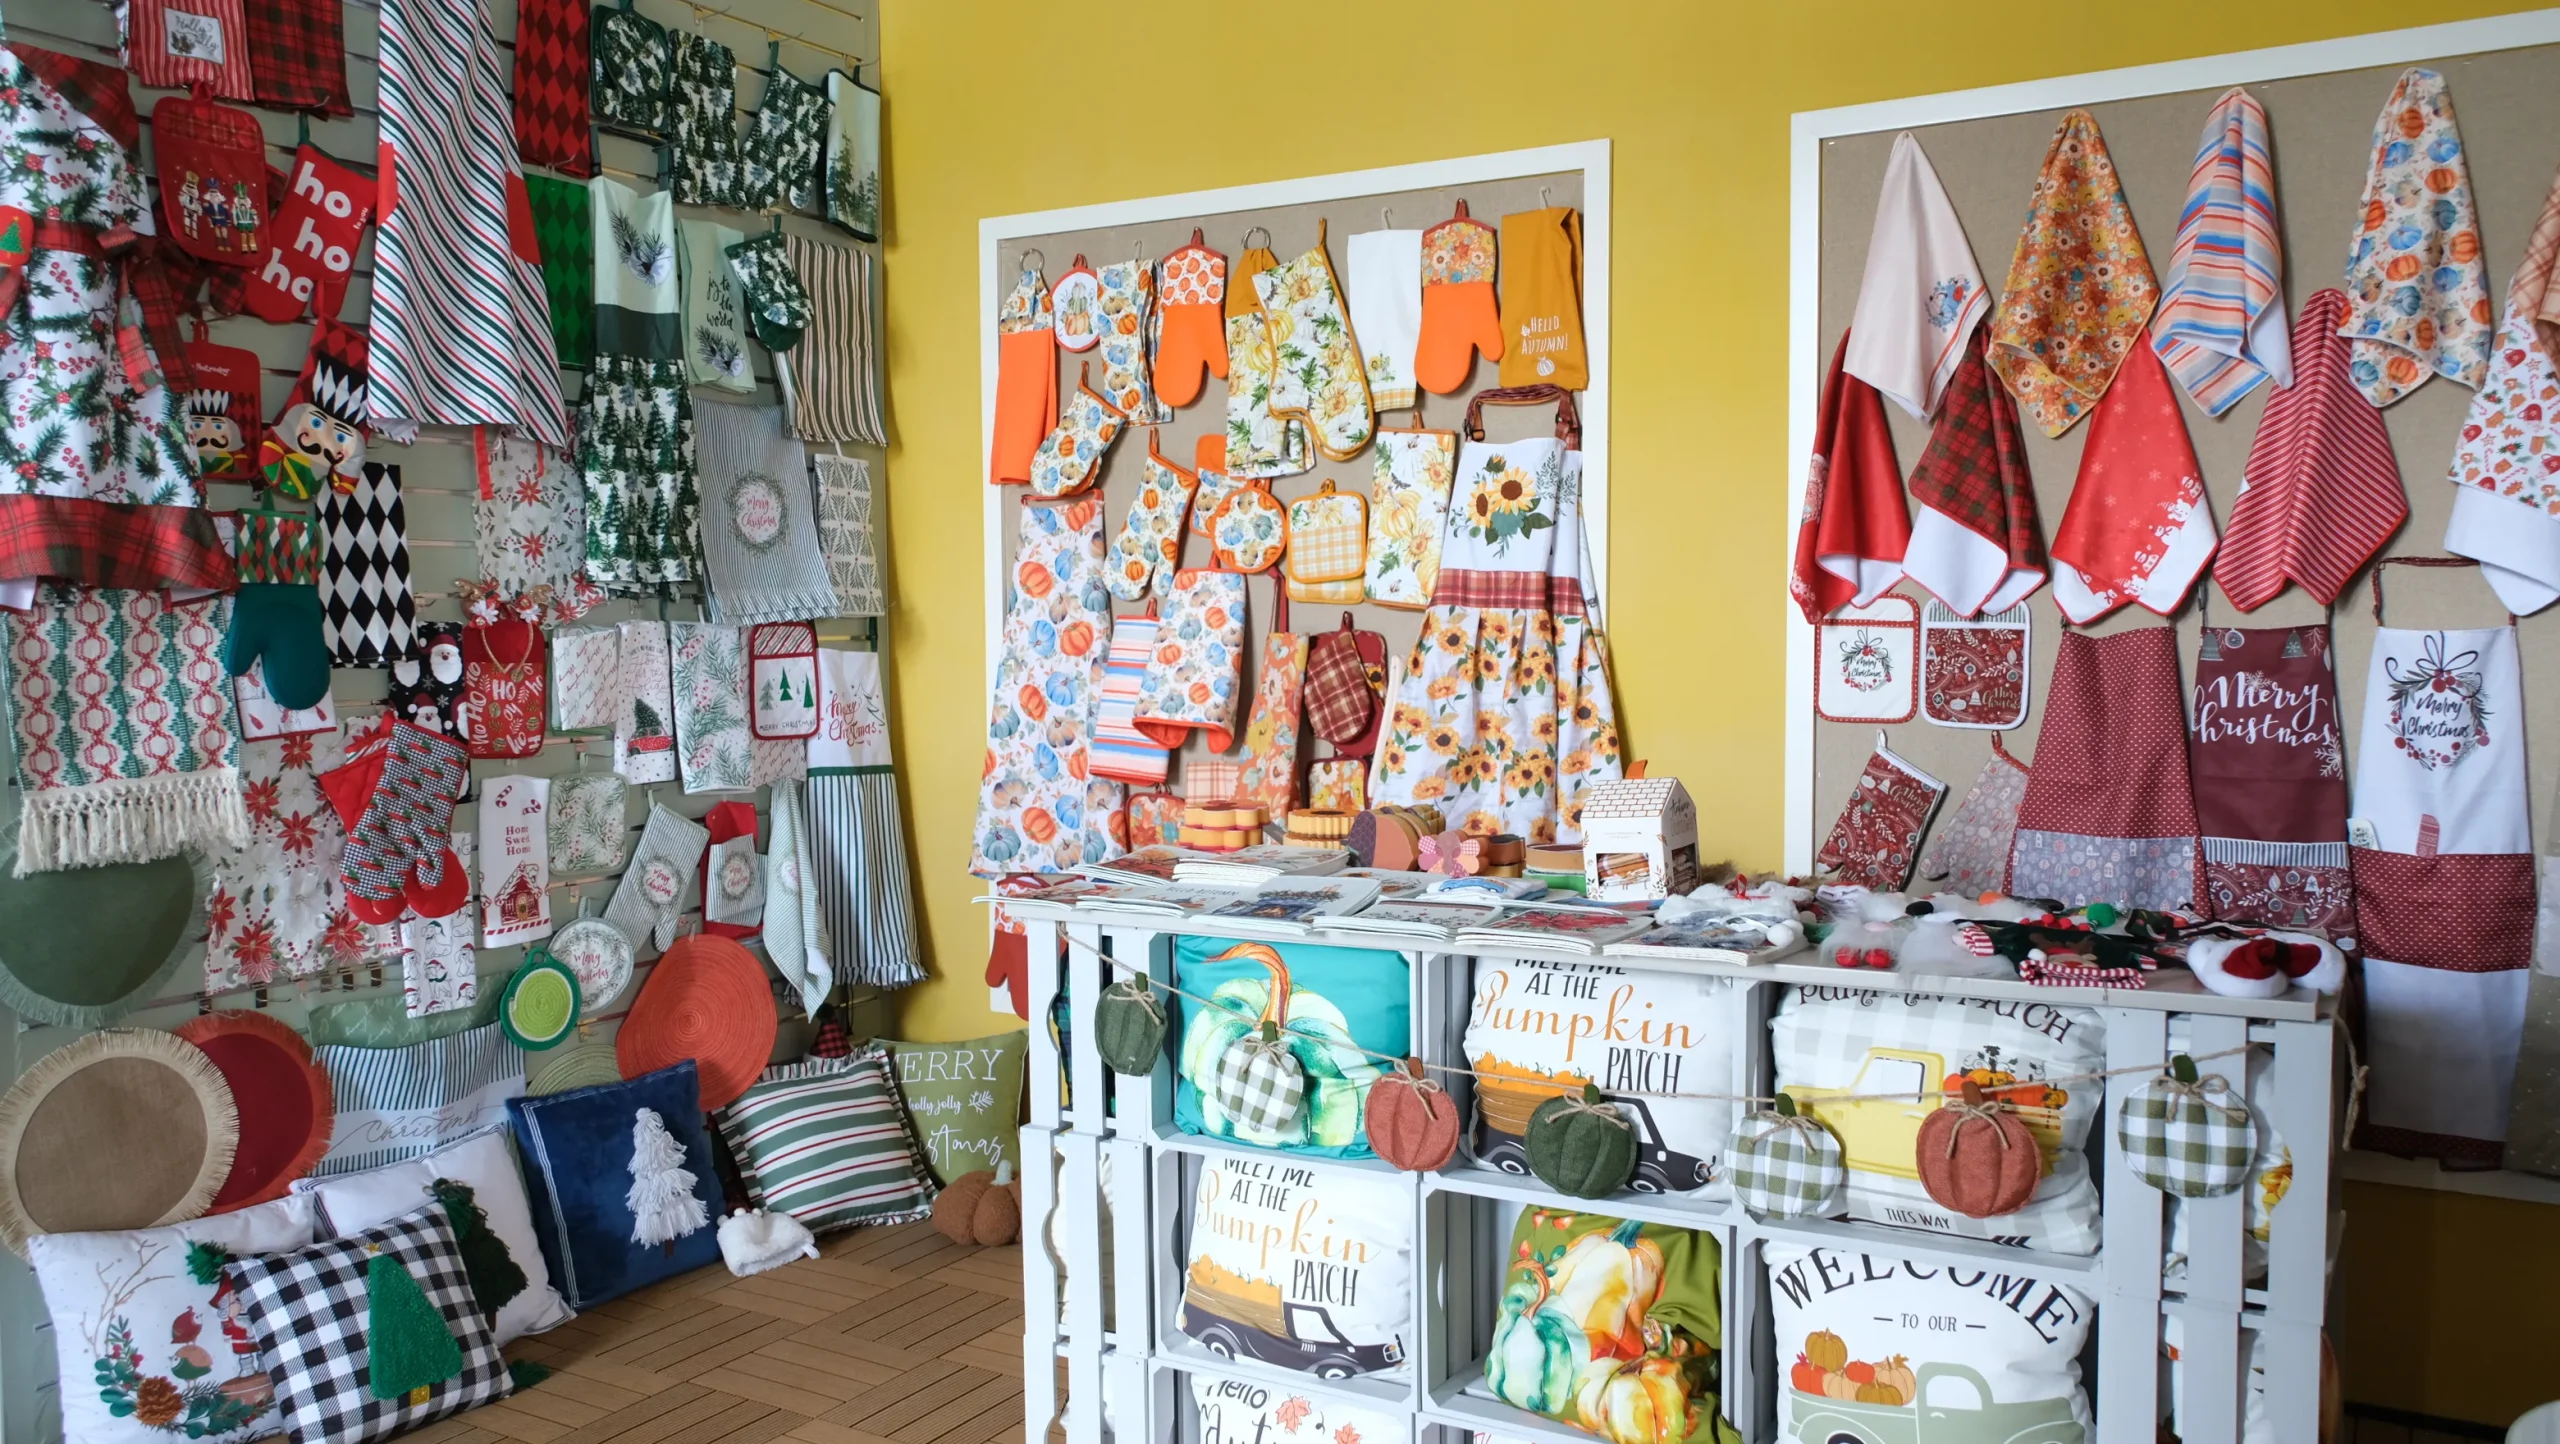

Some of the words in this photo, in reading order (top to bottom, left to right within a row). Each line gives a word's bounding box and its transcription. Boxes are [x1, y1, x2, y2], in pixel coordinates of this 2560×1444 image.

[294, 160, 352, 218] ho
[293, 216, 351, 272] ho
[261, 247, 314, 302] ho
[1530, 315, 1560, 333] HELLO
[1521, 332, 1568, 355] AUTUMN!
[746, 495, 769, 516] Merry
[741, 512, 778, 530] Christmas
[1851, 668, 1882, 678] Christmas
[1856, 656, 1877, 669] Merry
[492, 679, 516, 701] HO
[2208, 671, 2328, 732] Merry
[826, 693, 862, 725] Merry
[2416, 692, 2463, 721] Merry
[828, 718, 877, 747] Christmas
[2406, 716, 2471, 738] Christmas
[573, 951, 601, 968] Merry
[574, 968, 609, 984] hristmas
[1562, 974, 1602, 1000] THE
[1470, 969, 1707, 1063] Pumpkin
[1605, 1046, 1683, 1098] PATCH
[908, 1096, 934, 1116] holly
[933, 1095, 962, 1115] jolly
[345, 1103, 492, 1145] Christmas
[1258, 1183, 1291, 1212] THE
[1196, 1168, 1382, 1270] Pumpkin
[1884, 1207, 1917, 1224] THIS
[1918, 1212, 1951, 1230] WAY
[1292, 1258, 1360, 1307] PATCH
[1899, 1312, 1919, 1329] TO
[1928, 1315, 1957, 1332] OUR
